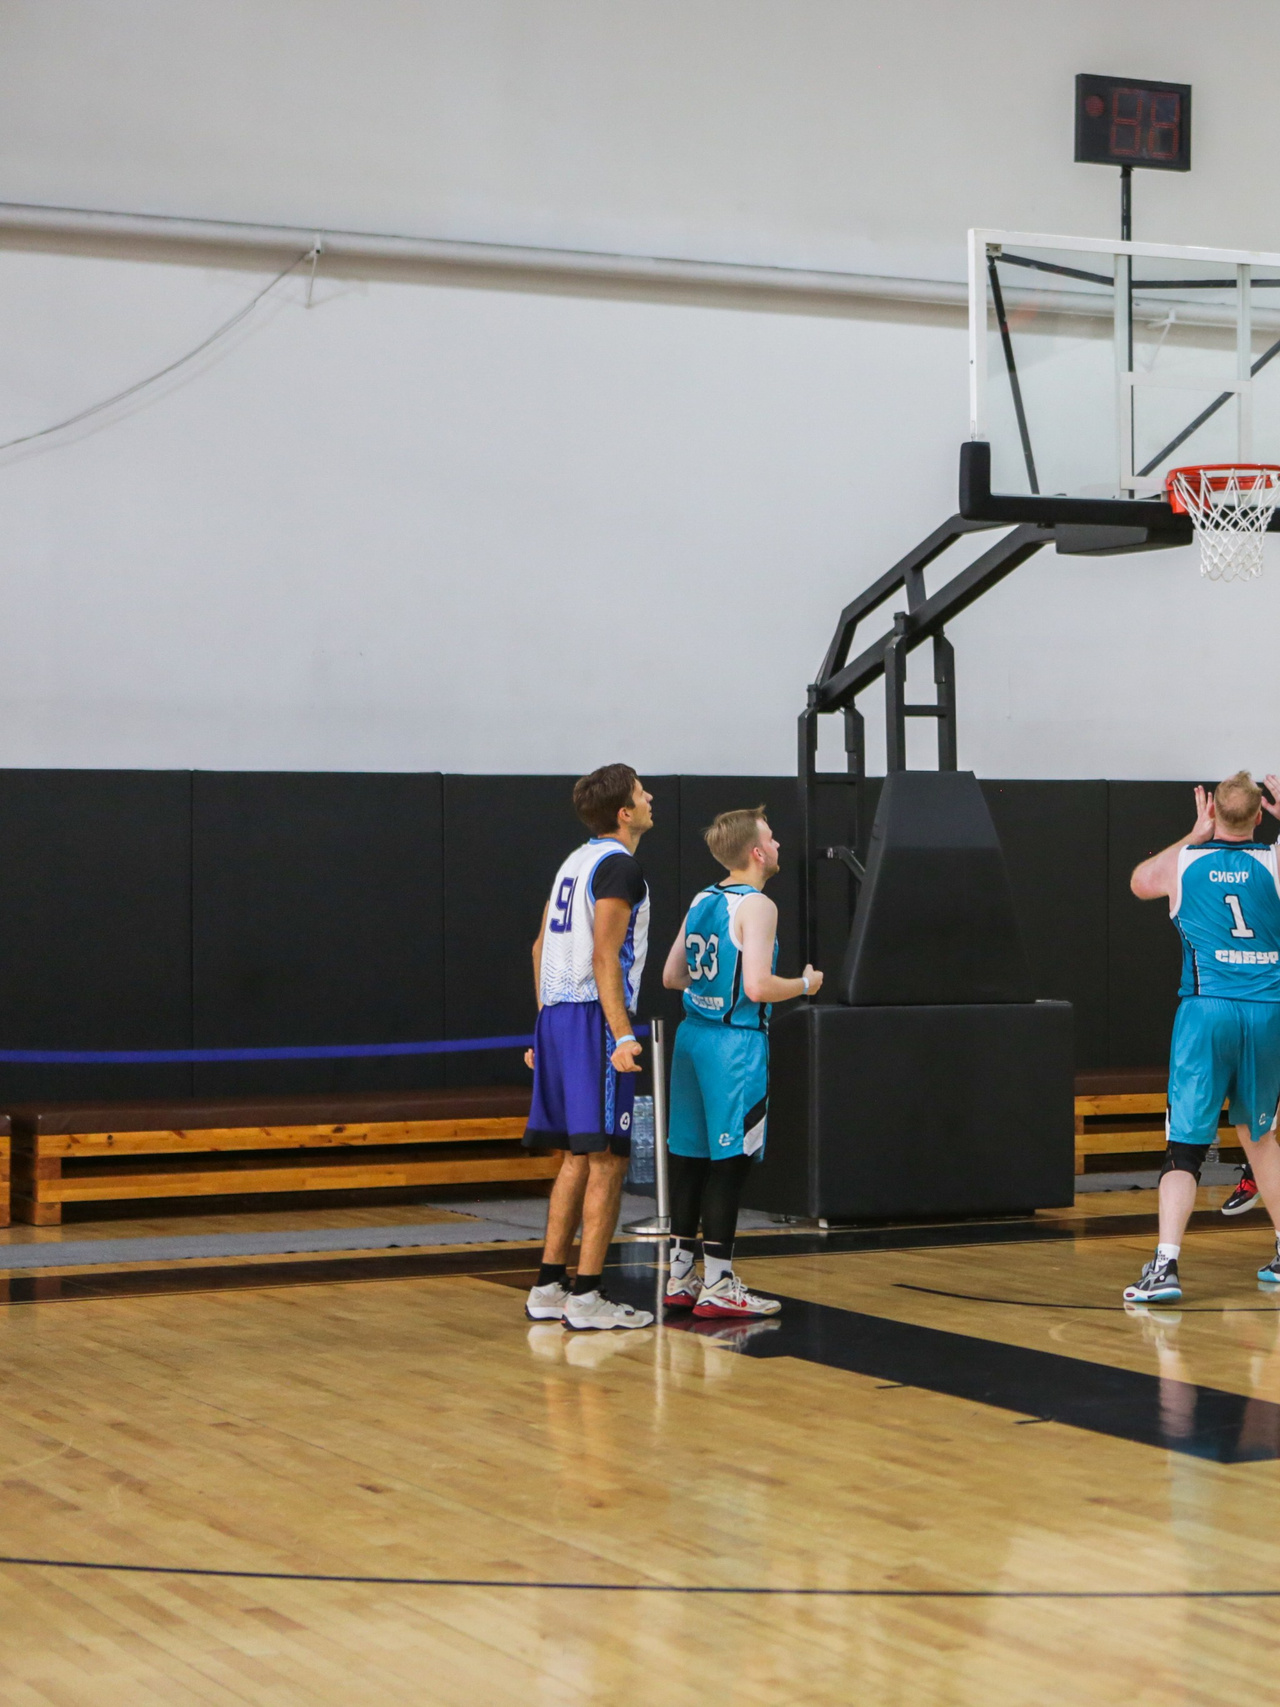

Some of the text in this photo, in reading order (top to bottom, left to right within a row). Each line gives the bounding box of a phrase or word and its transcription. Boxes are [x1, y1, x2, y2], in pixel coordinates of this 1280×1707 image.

[1209, 870, 1249, 883] СИБУР
[1223, 893, 1255, 939] 1
[685, 932, 719, 982] 33
[1215, 949, 1279, 964] СИБУР
